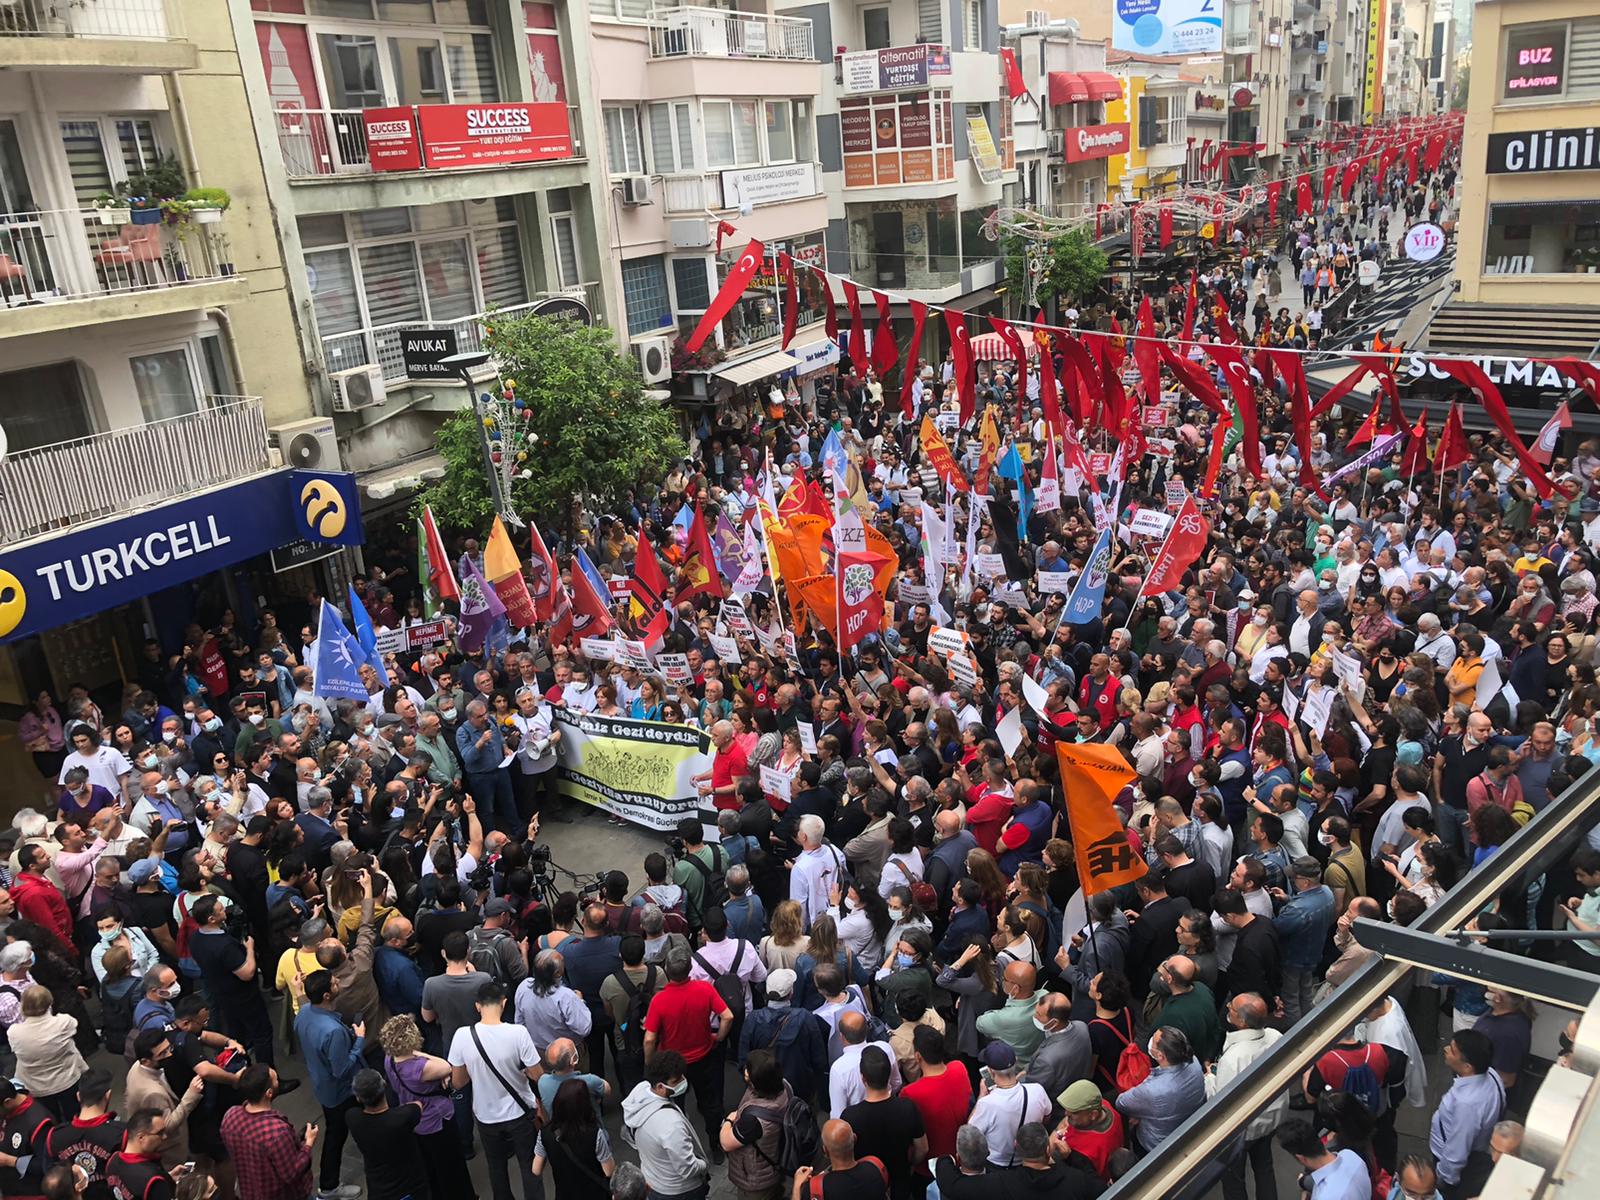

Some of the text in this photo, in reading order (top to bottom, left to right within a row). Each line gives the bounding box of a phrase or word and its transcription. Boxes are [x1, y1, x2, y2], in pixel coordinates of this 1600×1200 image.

[880, 48, 925, 64] alternatif
[1519, 48, 1552, 65] BUZ
[885, 63, 918, 74] YURTDIŞI
[890, 73, 915, 83] EĞİTİM
[1509, 76, 1558, 88] EPİLASYON
[466, 108, 530, 128] SUCCESS
[370, 122, 407, 134] SUCCESS
[1505, 128, 1600, 171] clini
[408, 339, 447, 352] AVUKAT
[36, 514, 231, 601] TURKCELL
[1075, 596, 1094, 613] HDP
[846, 610, 868, 634] HDP
[416, 626, 437, 636] HEPİMİZ
